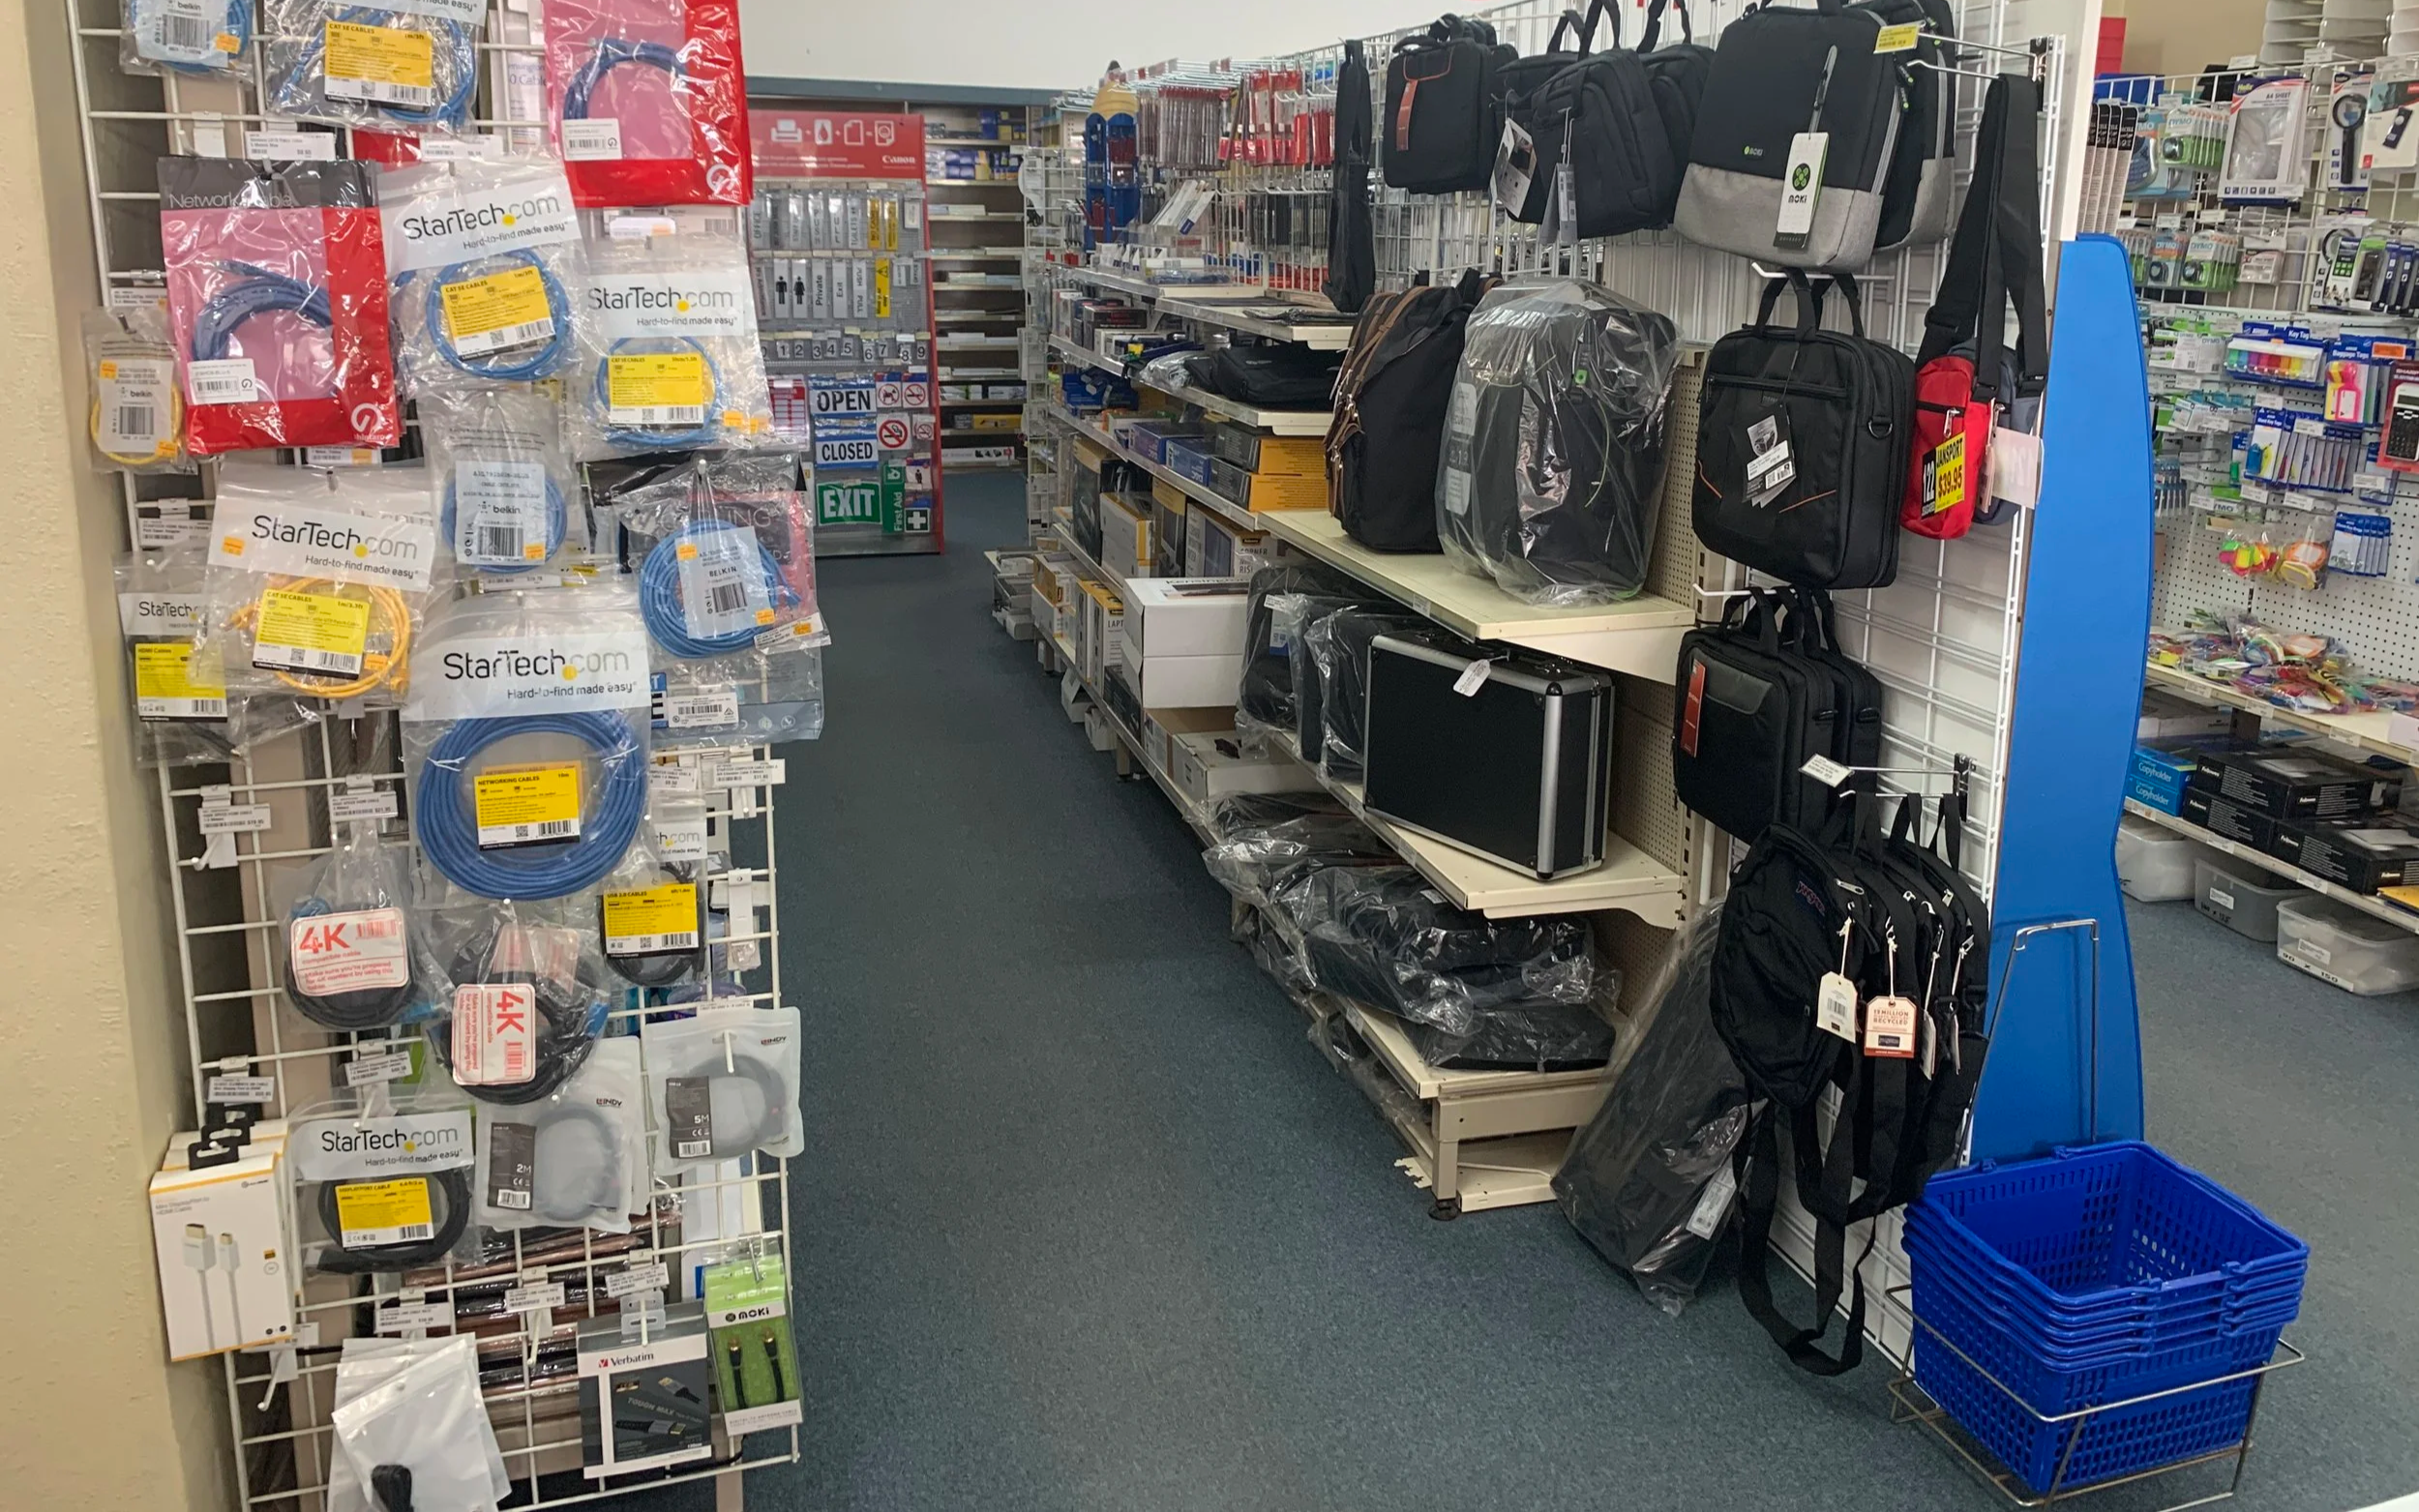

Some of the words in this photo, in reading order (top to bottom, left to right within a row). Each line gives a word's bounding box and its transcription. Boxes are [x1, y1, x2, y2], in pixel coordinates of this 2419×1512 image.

[177, 1, 201, 11] belkin
[2237, 83, 2254, 92] Helix
[2168, 117, 2192, 126] DYMO
[881, 155, 916, 163] Canon
[403, 195, 560, 240] StarTech.com
[463, 231, 516, 250] Hard-to-find
[517, 226, 542, 237] made
[544, 223, 565, 234] easy
[466, 280, 488, 289] CABLES
[815, 275, 823, 307] Private
[587, 287, 733, 312] StarTech.com
[637, 317, 687, 326] Hard-to-find
[714, 318, 733, 327] easy
[2287, 330, 2301, 339] Key
[780, 343, 787, 355] 1
[794, 344, 803, 356] 2
[814, 345, 821, 357] 3
[826, 343, 835, 355] 4
[844, 342, 851, 354] 5
[879, 344, 887, 355] 7
[917, 345, 925, 358] 9
[865, 348, 873, 361] 6
[901, 349, 910, 361] 8
[2332, 350, 2355, 359] Baggage
[130, 389, 153, 399] belkin
[817, 391, 871, 411] OPEN
[822, 442, 873, 461] CLOSED
[1936, 437, 1963, 468] JANSPORT
[1938, 464, 1962, 498] $39.95
[824, 489, 876, 519] EXIT
[893, 491, 903, 508] Aid
[493, 504, 522, 514] belkin
[893, 509, 903, 531] First
[252, 515, 418, 560] StarTech.com
[305, 554, 363, 572] Hard-to-find
[364, 562, 390, 575] made
[392, 564, 414, 579] easy
[709, 566, 737, 577] BELKIN
[287, 594, 313, 603] CABLES
[1108, 619, 1124, 628] LAPT
[443, 648, 629, 681] StarTech.com
[576, 684, 605, 695] made
[607, 681, 633, 694] easy
[2137, 761, 2171, 784] Copyholder
[2200, 765, 2220, 777] Fellowes
[2135, 785, 2169, 807] Copyholder
[2189, 800, 2206, 811] Fellowes
[2280, 835, 2299, 847] Fellowes
[299, 921, 350, 954] 4K
[2283, 952, 2295, 963] 90
[2321, 971, 2338, 983] 150
[496, 991, 524, 1034] 4K
[694, 1114, 709, 1124] 5M
[321, 1127, 459, 1153] StarTech.com
[365, 1156, 414, 1167] Hard-to-find
[415, 1154, 437, 1163] made
[439, 1150, 460, 1159] easy
[516, 1164, 531, 1172] 2M
[738, 1307, 769, 1319] moki
[611, 1351, 654, 1367] Verbatim
[627, 1397, 655, 1411] TOUGH
[656, 1406, 675, 1416] MAX
